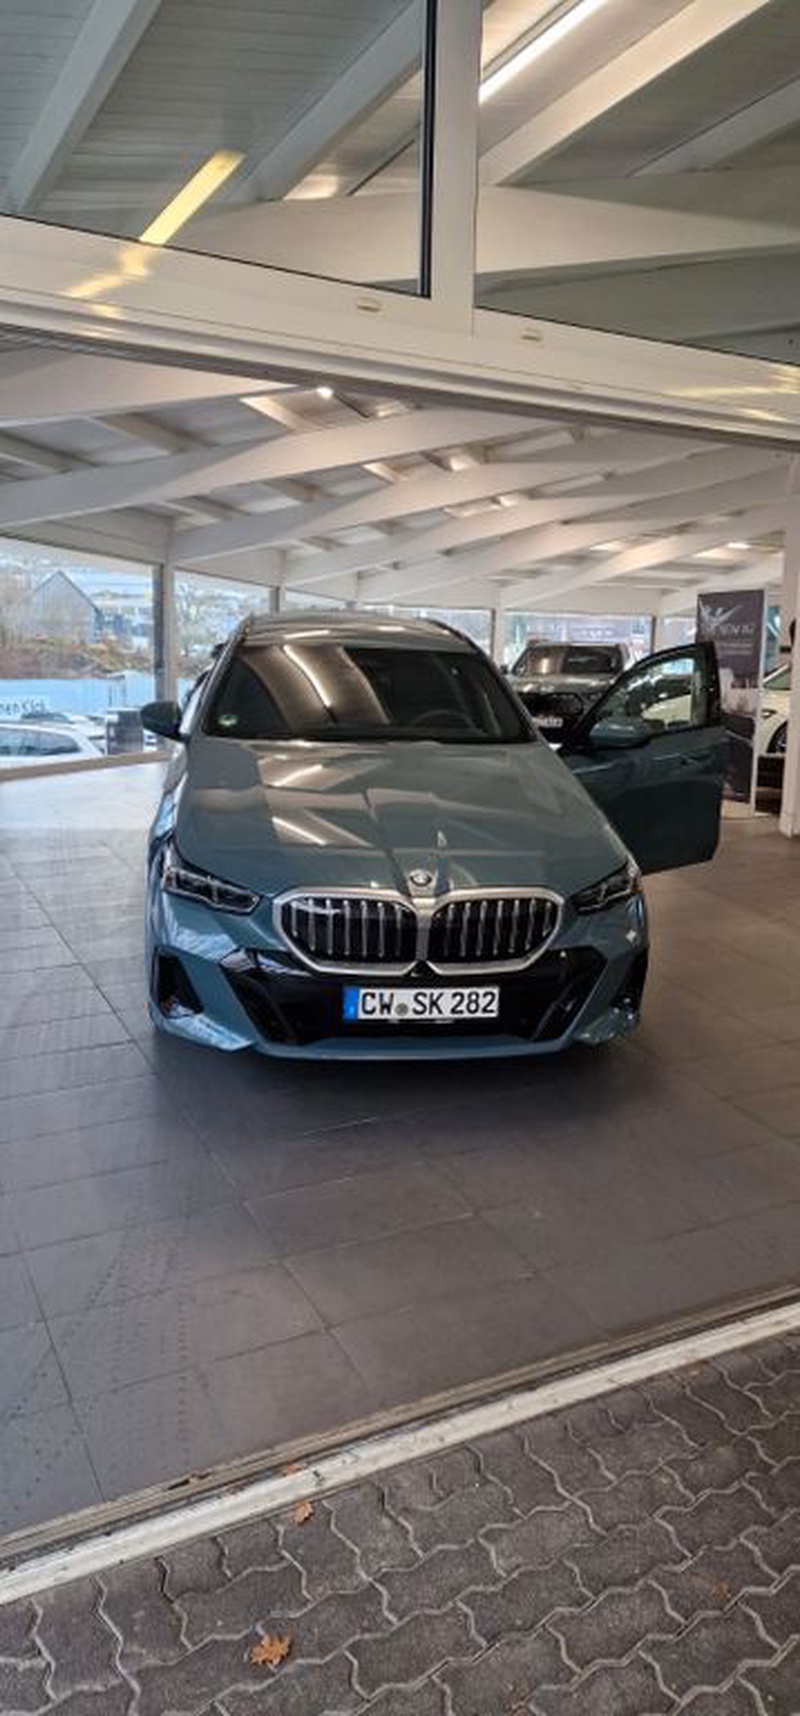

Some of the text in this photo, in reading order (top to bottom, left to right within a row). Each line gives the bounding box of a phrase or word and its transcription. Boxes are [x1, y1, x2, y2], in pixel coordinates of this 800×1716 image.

[361, 991, 497, 1015] CW SK 282
